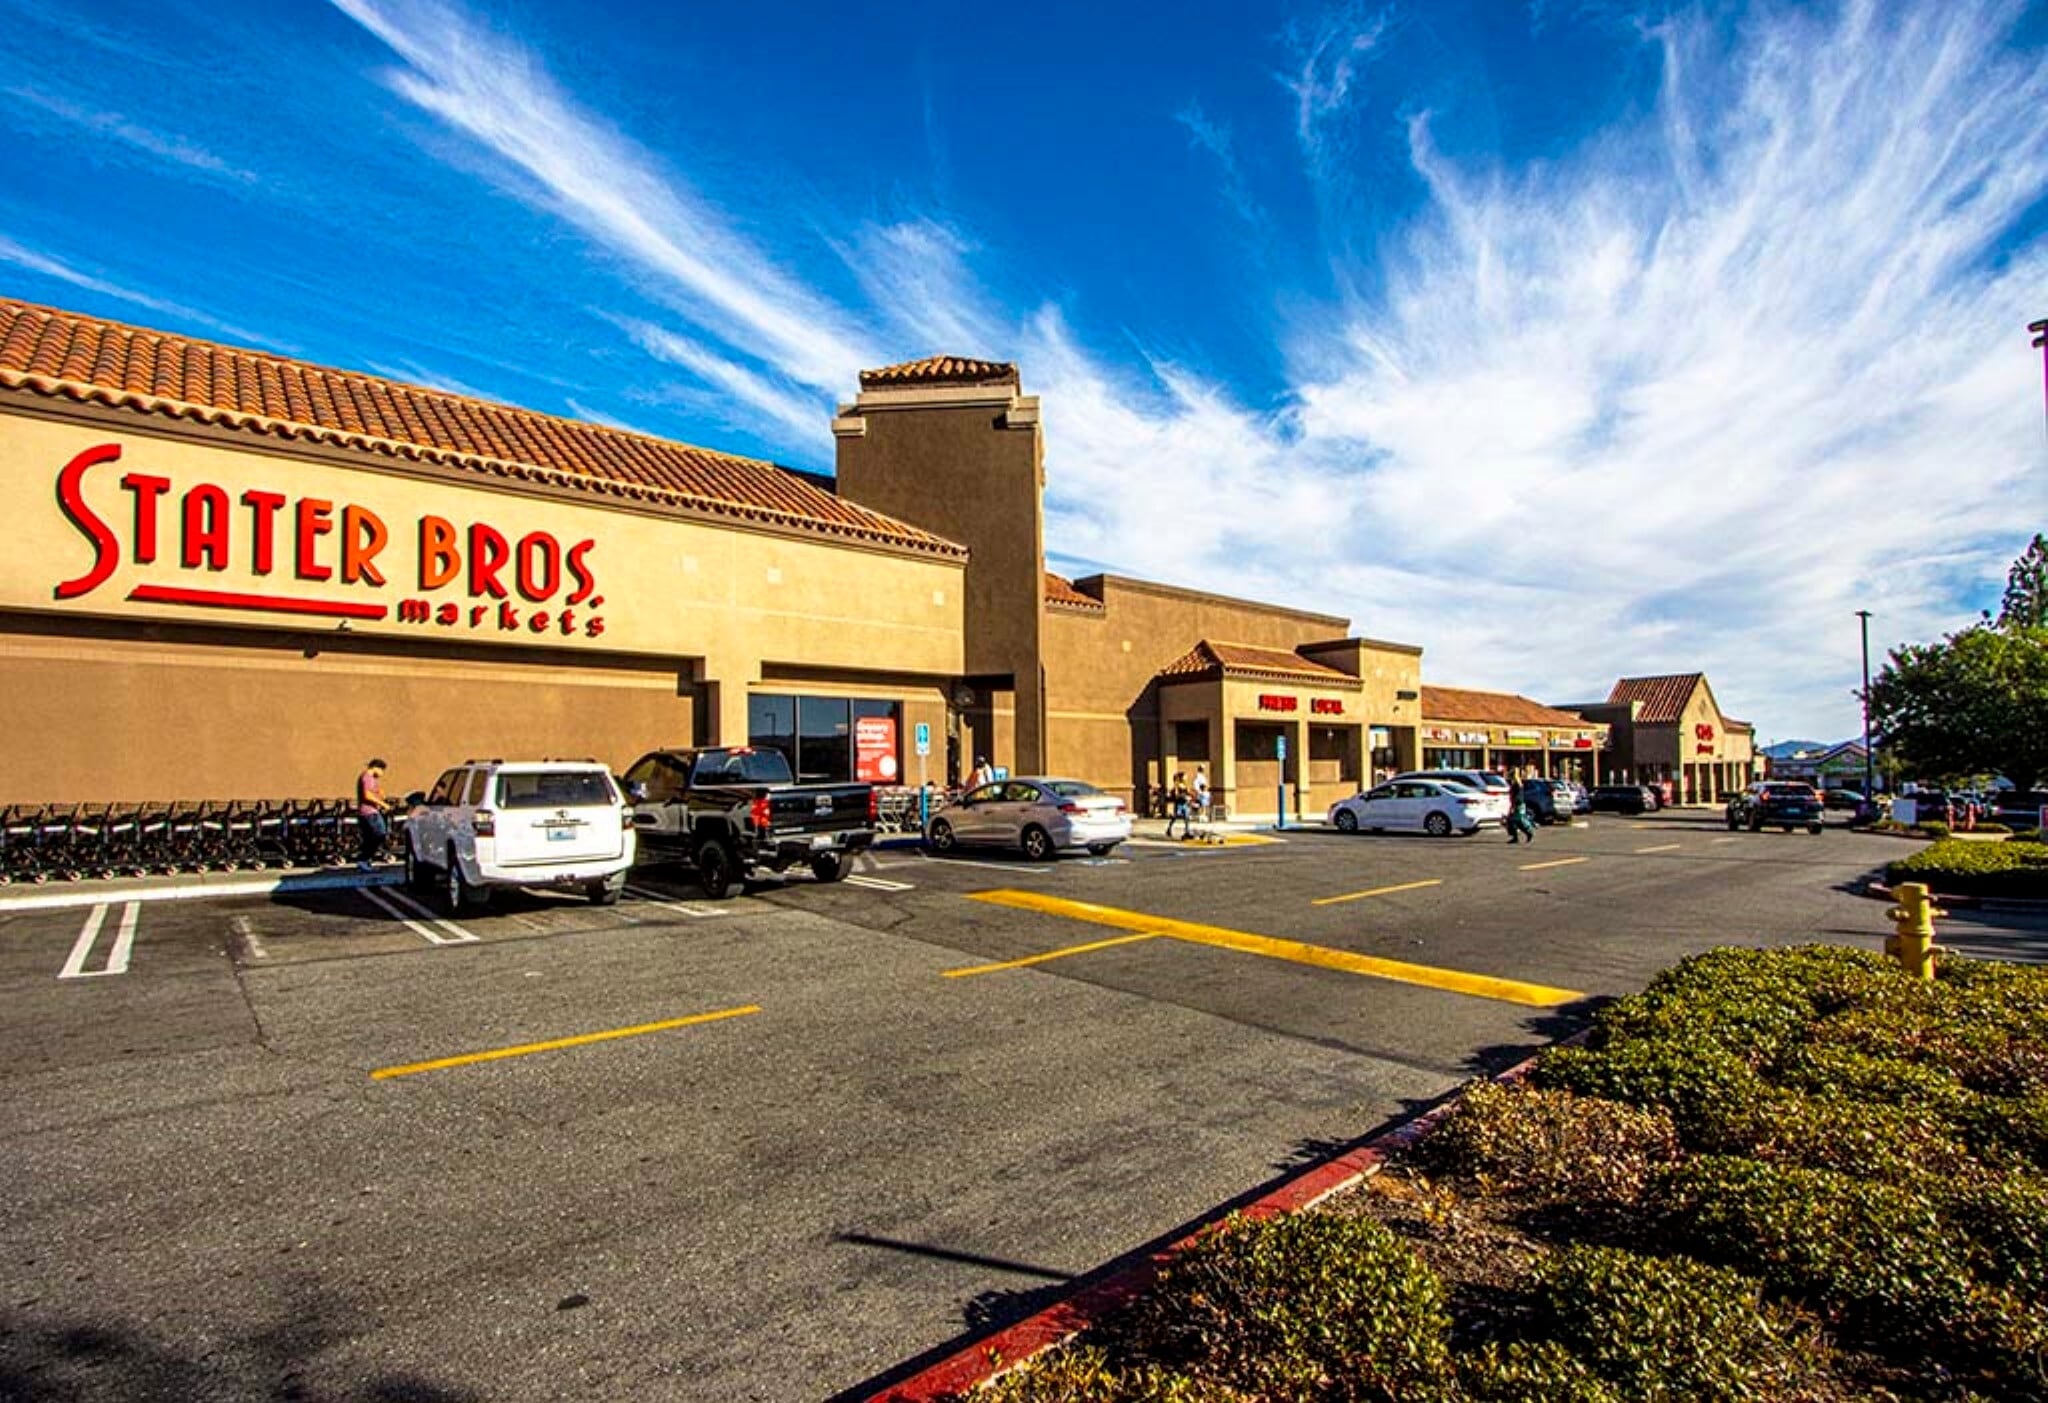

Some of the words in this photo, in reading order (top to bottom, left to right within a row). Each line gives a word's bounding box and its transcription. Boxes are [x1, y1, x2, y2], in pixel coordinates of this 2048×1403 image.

[54, 443, 388, 600] STATER
[418, 514, 605, 608] BROS.
[398, 598, 605, 637] markets
